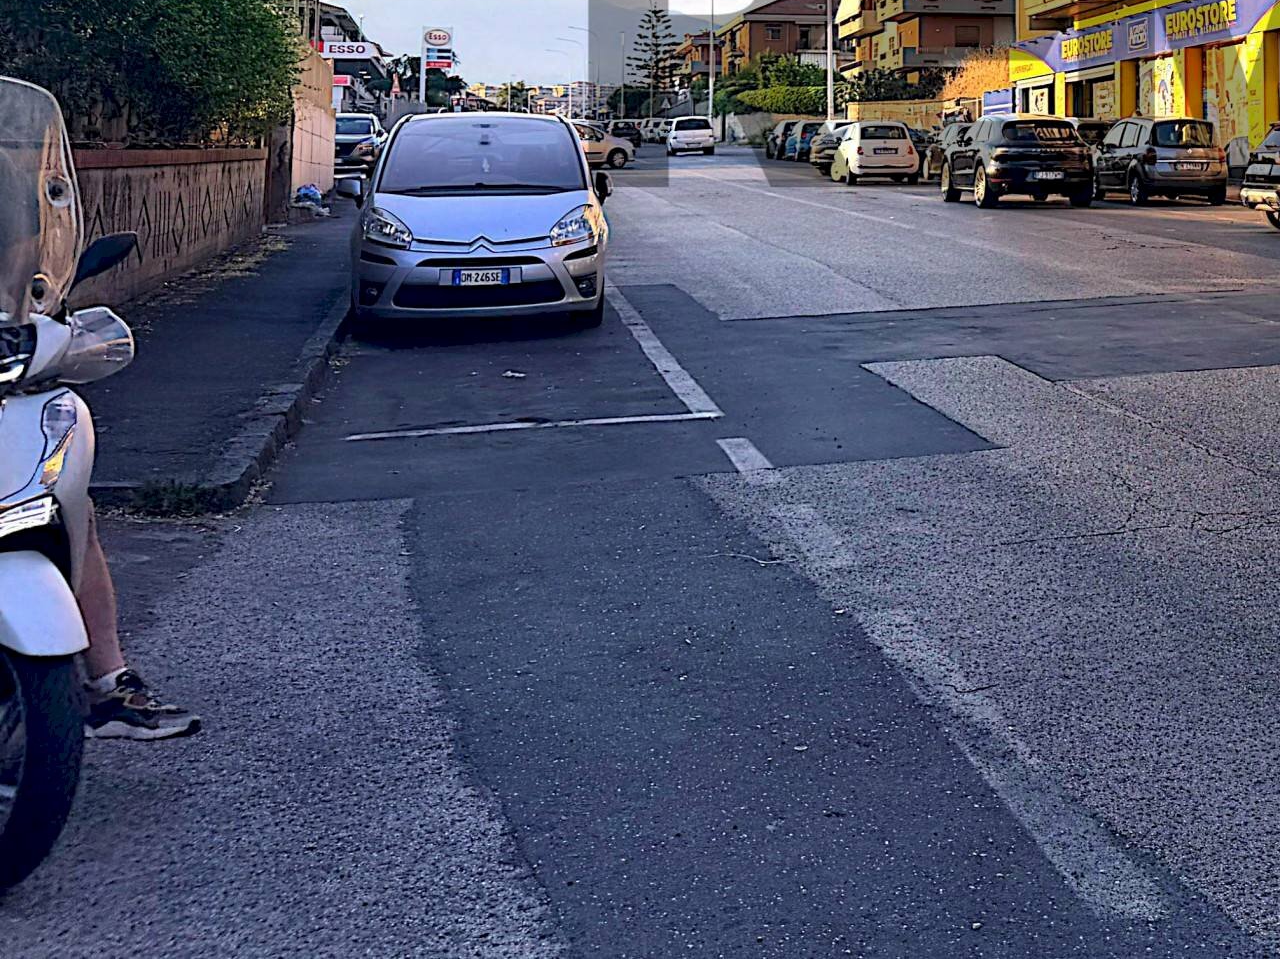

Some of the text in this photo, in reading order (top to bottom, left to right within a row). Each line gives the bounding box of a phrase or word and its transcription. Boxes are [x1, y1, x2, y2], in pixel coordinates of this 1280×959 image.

[428, 31, 448, 41] Esso
[329, 44, 366, 54] ESSO
[1061, 29, 1113, 59] EUROSTORE
